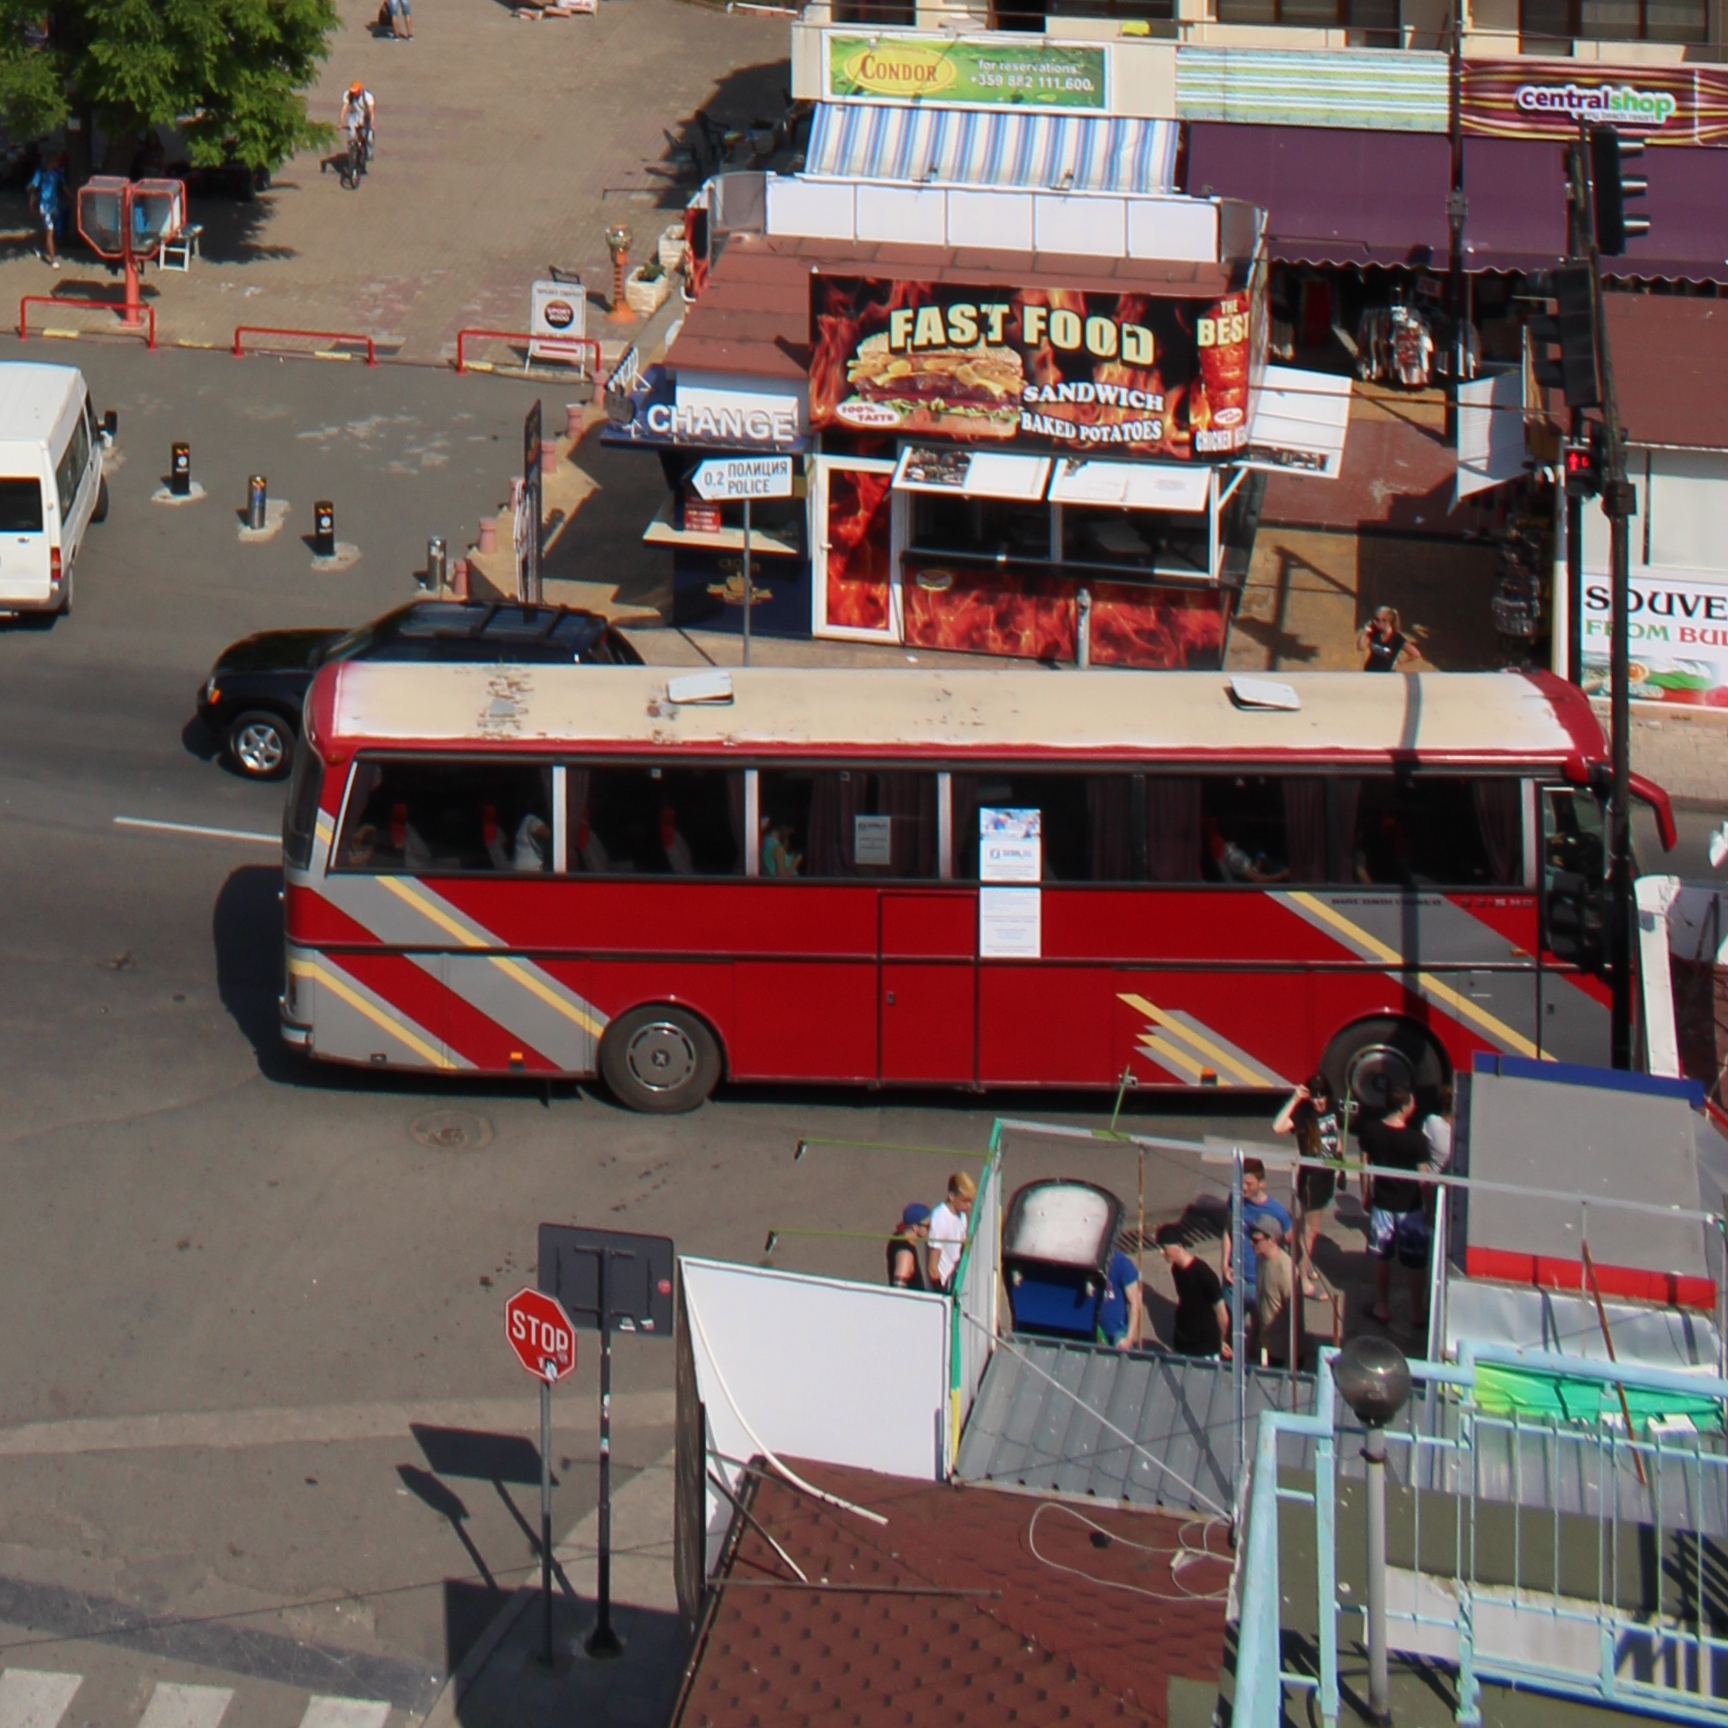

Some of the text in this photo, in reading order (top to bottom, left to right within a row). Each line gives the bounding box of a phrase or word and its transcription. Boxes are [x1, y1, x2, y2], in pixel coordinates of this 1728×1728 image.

[860, 54, 937, 82] CONDOR
[978, 58, 996, 72] for
[1521, 87, 1672, 121] centralshop
[1221, 300, 1238, 313] THE
[890, 303, 1155, 365] FAST FOOD
[1023, 382, 1165, 412] SANDWICH
[647, 404, 795, 442] CHANGE
[1020, 411, 1163, 442] BAKED POTATOES
[728, 460, 788, 479] ПОЛИЦИЯ
[728, 479, 771, 494] POLICE
[512, 1309, 569, 1353] STOP
